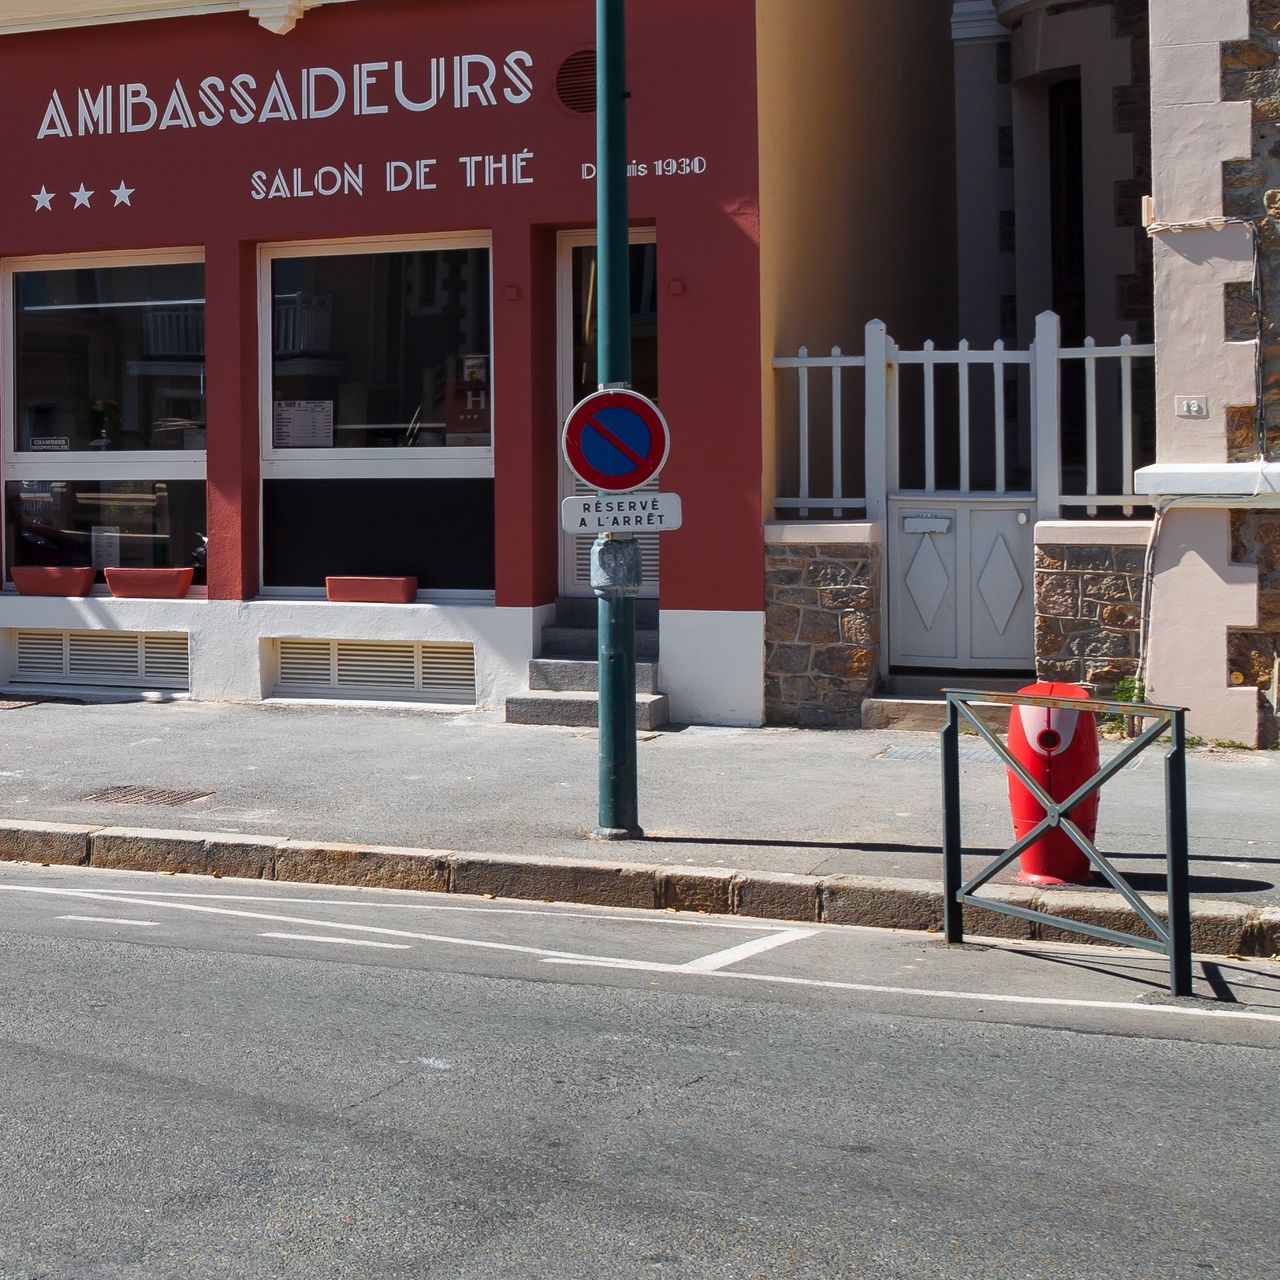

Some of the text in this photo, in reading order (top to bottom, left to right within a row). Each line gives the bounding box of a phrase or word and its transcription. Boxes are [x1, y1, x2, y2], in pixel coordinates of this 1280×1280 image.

[36, 50, 534, 140] AMBASSADEURS
[250, 148, 534, 200] SALON DE THÉ
[653, 156, 707, 176] 1930
[465, 390, 486, 410] H
[583, 498, 659, 513] RÉSERVÉ
[579, 513, 664, 527] A L'ARRÊT
